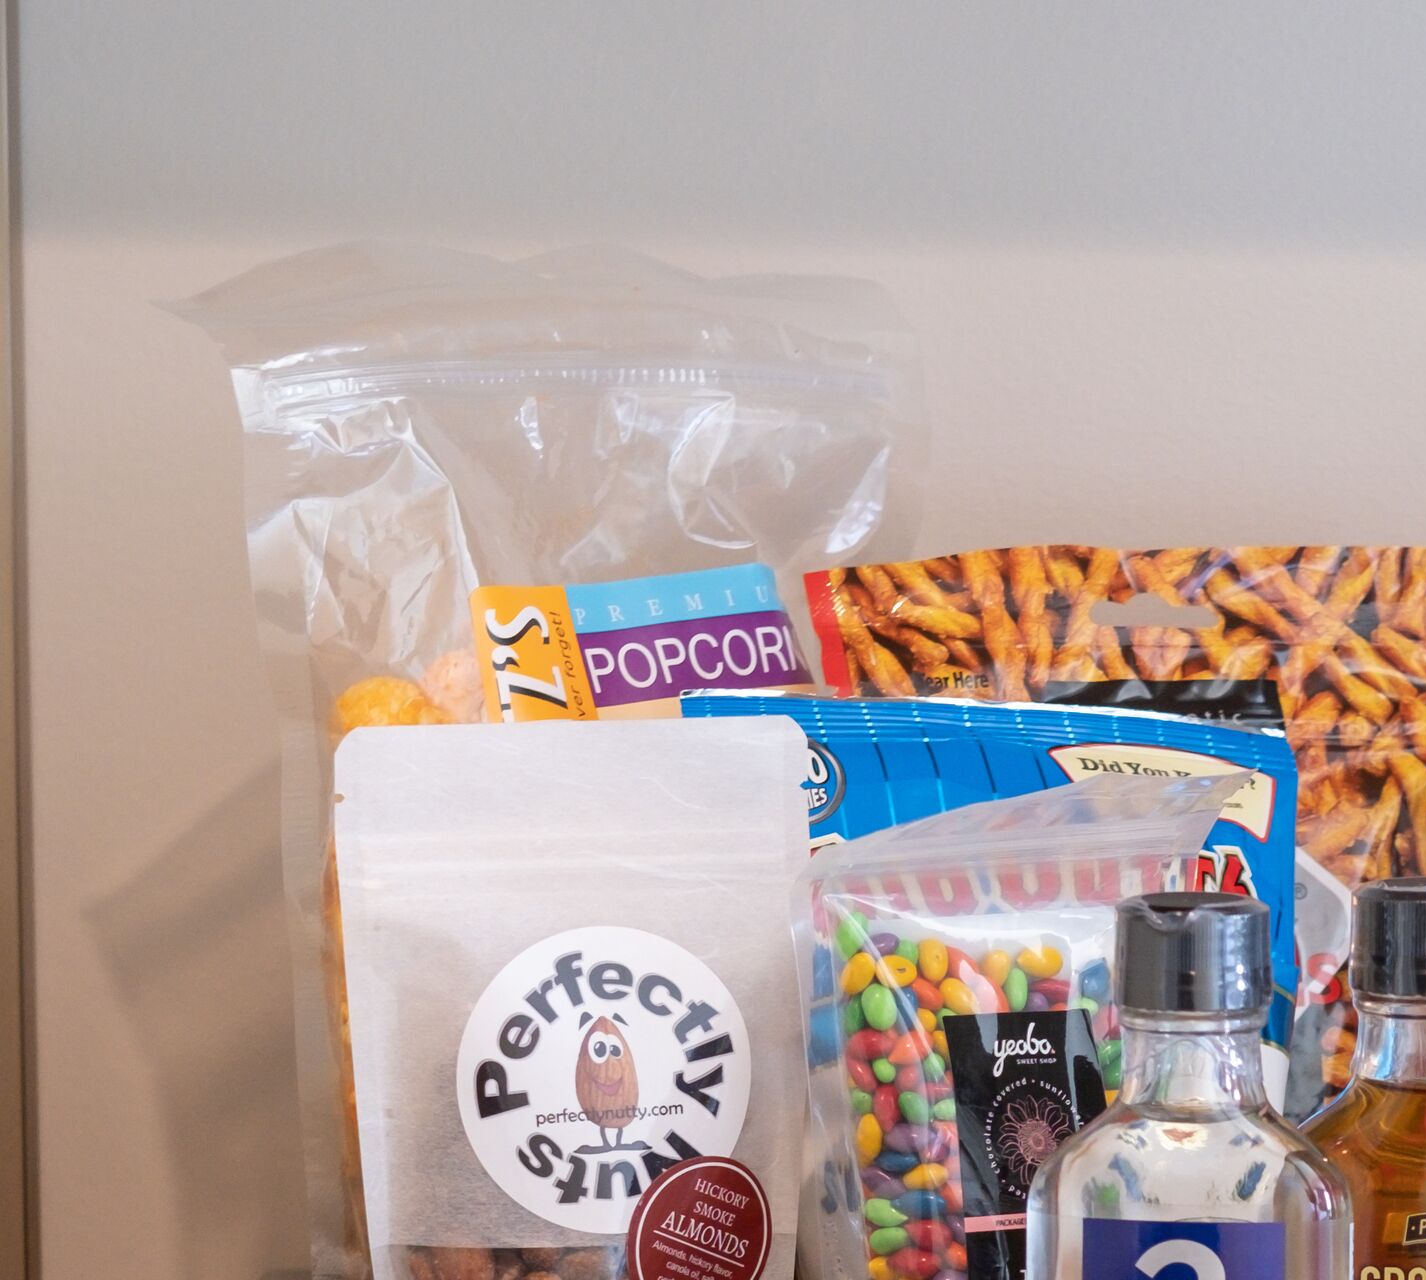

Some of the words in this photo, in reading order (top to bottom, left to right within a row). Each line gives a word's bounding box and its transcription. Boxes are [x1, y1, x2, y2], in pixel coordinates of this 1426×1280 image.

[574, 584, 771, 626] PREMIU
[952, 672, 990, 689] Here
[1077, 756, 1126, 774] Did
[474, 950, 735, 1120] Perfectly
[990, 1077, 1028, 1108] covered
[535, 1101, 685, 1128] perfectlynutty.com
[694, 1178, 750, 1210] HICKORY
[692, 1200, 737, 1228] SMOKE
[994, 1217, 1027, 1227] PACKAGE
[660, 1210, 750, 1259] ALMONDS
